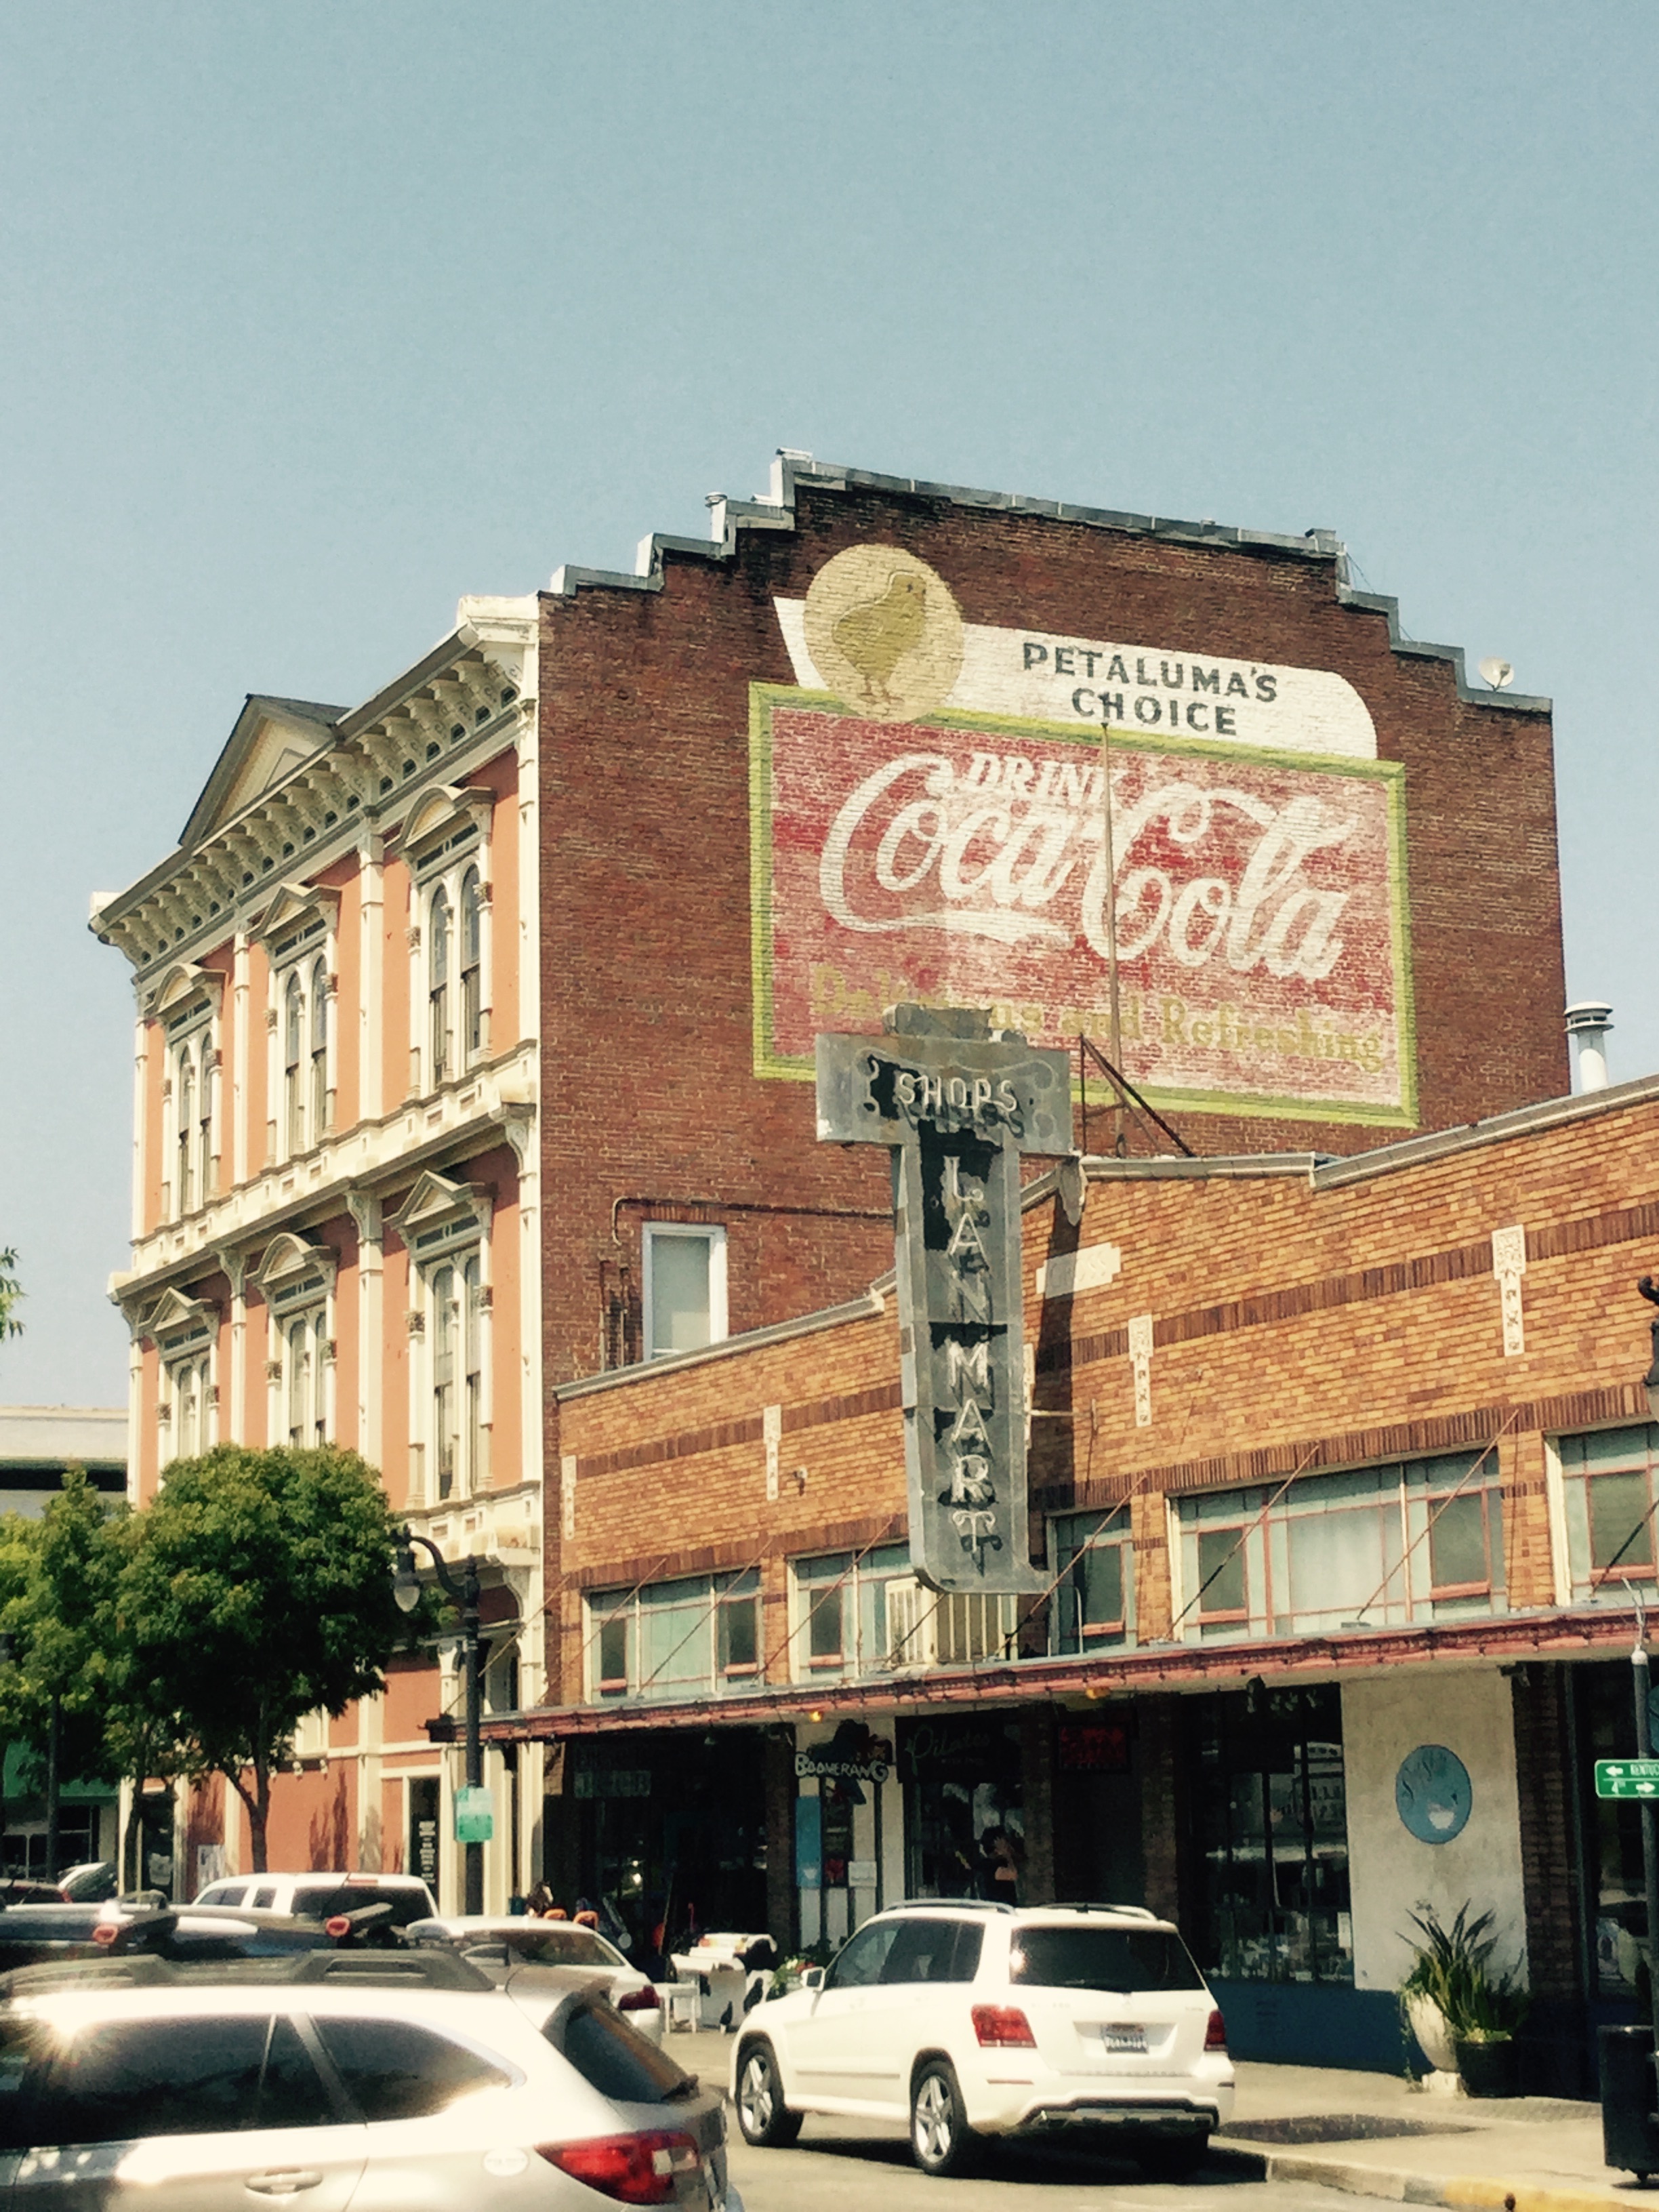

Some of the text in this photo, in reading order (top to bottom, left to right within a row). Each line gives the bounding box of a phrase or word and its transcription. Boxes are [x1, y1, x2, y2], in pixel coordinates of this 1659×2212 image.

[1023, 642, 1277, 703] PETALUMA'S
[1071, 687, 1237, 736] CHOICE
[965, 752, 1130, 813] DRINK
[1061, 994, 1143, 1040] and
[1158, 996, 1387, 1073] Refreshing
[899, 1072, 1017, 1112] SHOPS
[794, 1752, 888, 1783] BOOMERANG
